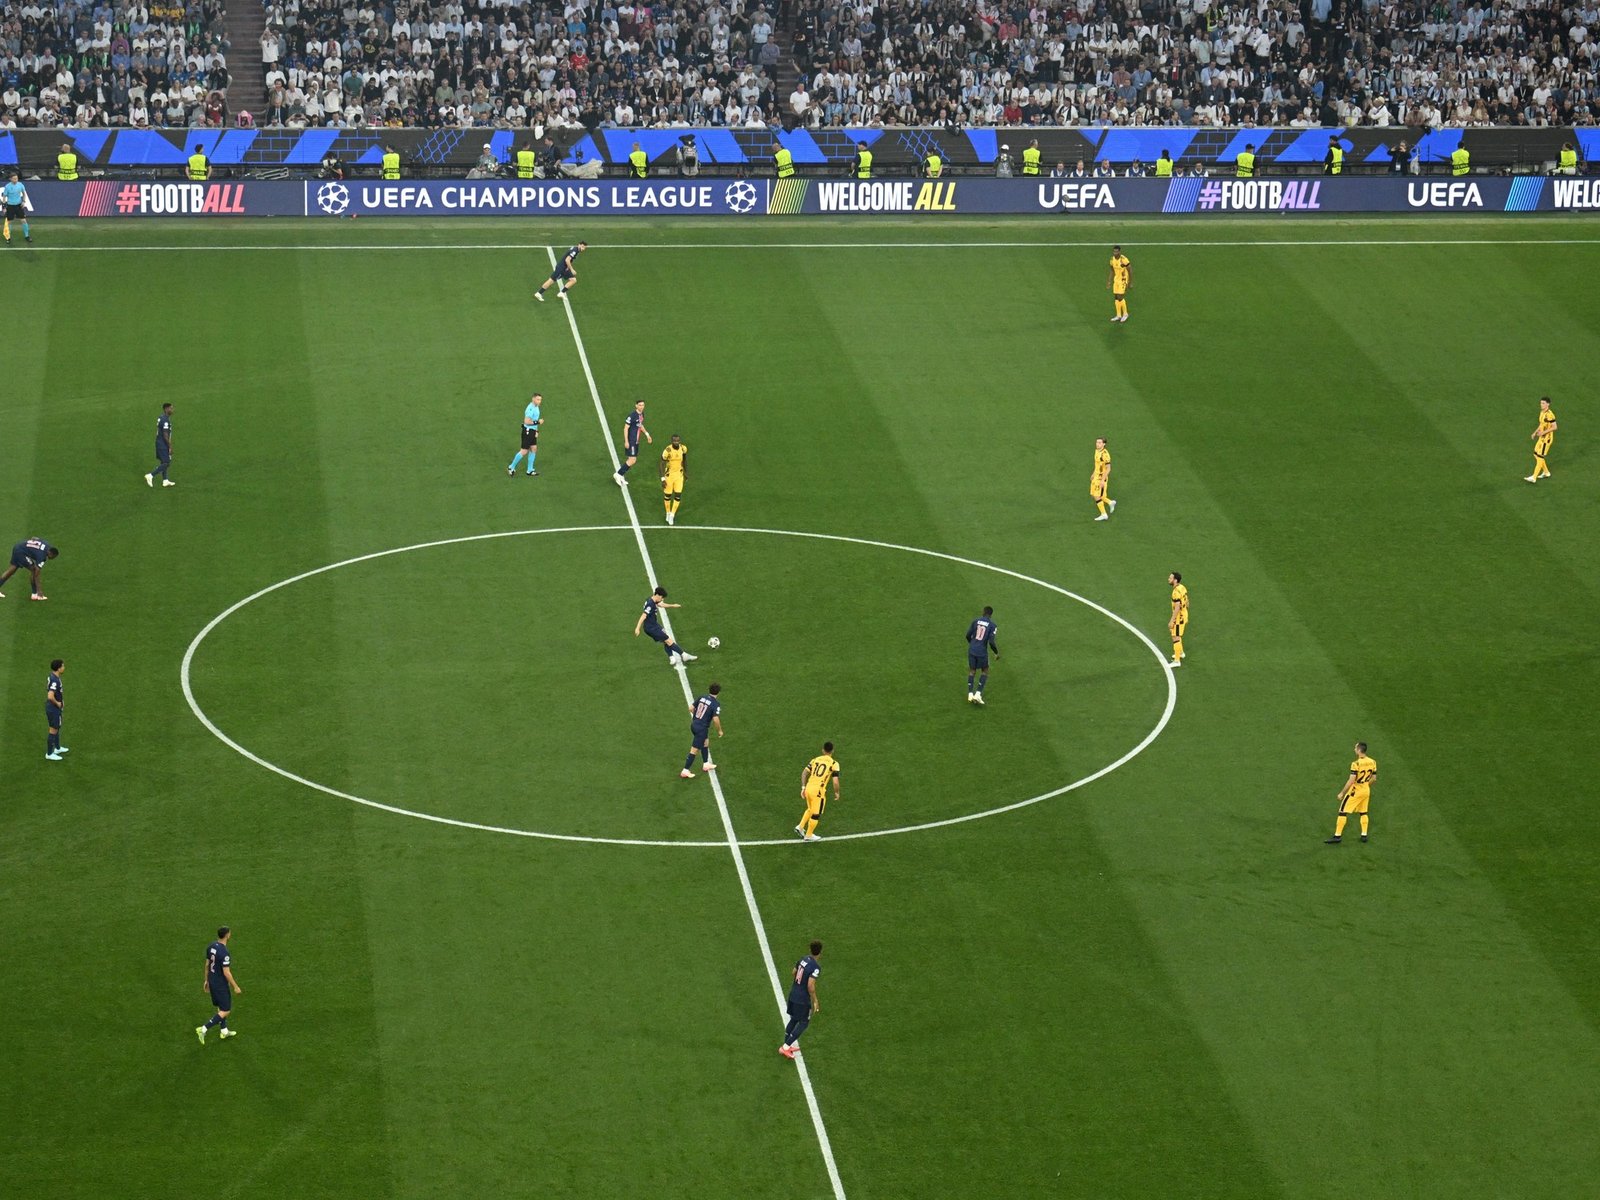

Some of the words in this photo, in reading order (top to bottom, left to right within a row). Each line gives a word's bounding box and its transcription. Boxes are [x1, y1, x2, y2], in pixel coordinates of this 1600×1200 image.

[116, 184, 245, 213] #FOOTBALL
[363, 187, 433, 209] UEFA
[440, 187, 601, 209] CHAMPIONS
[611, 186, 713, 208] LEAGUE
[818, 182, 912, 211] WELCOME
[913, 182, 956, 210] ALL
[1038, 183, 1116, 208] UEFA
[1199, 181, 1321, 210] #FOOTBALL
[1408, 183, 1484, 207] UEFA
[812, 762, 827, 777] 10
[1357, 769, 1373, 783] 22
